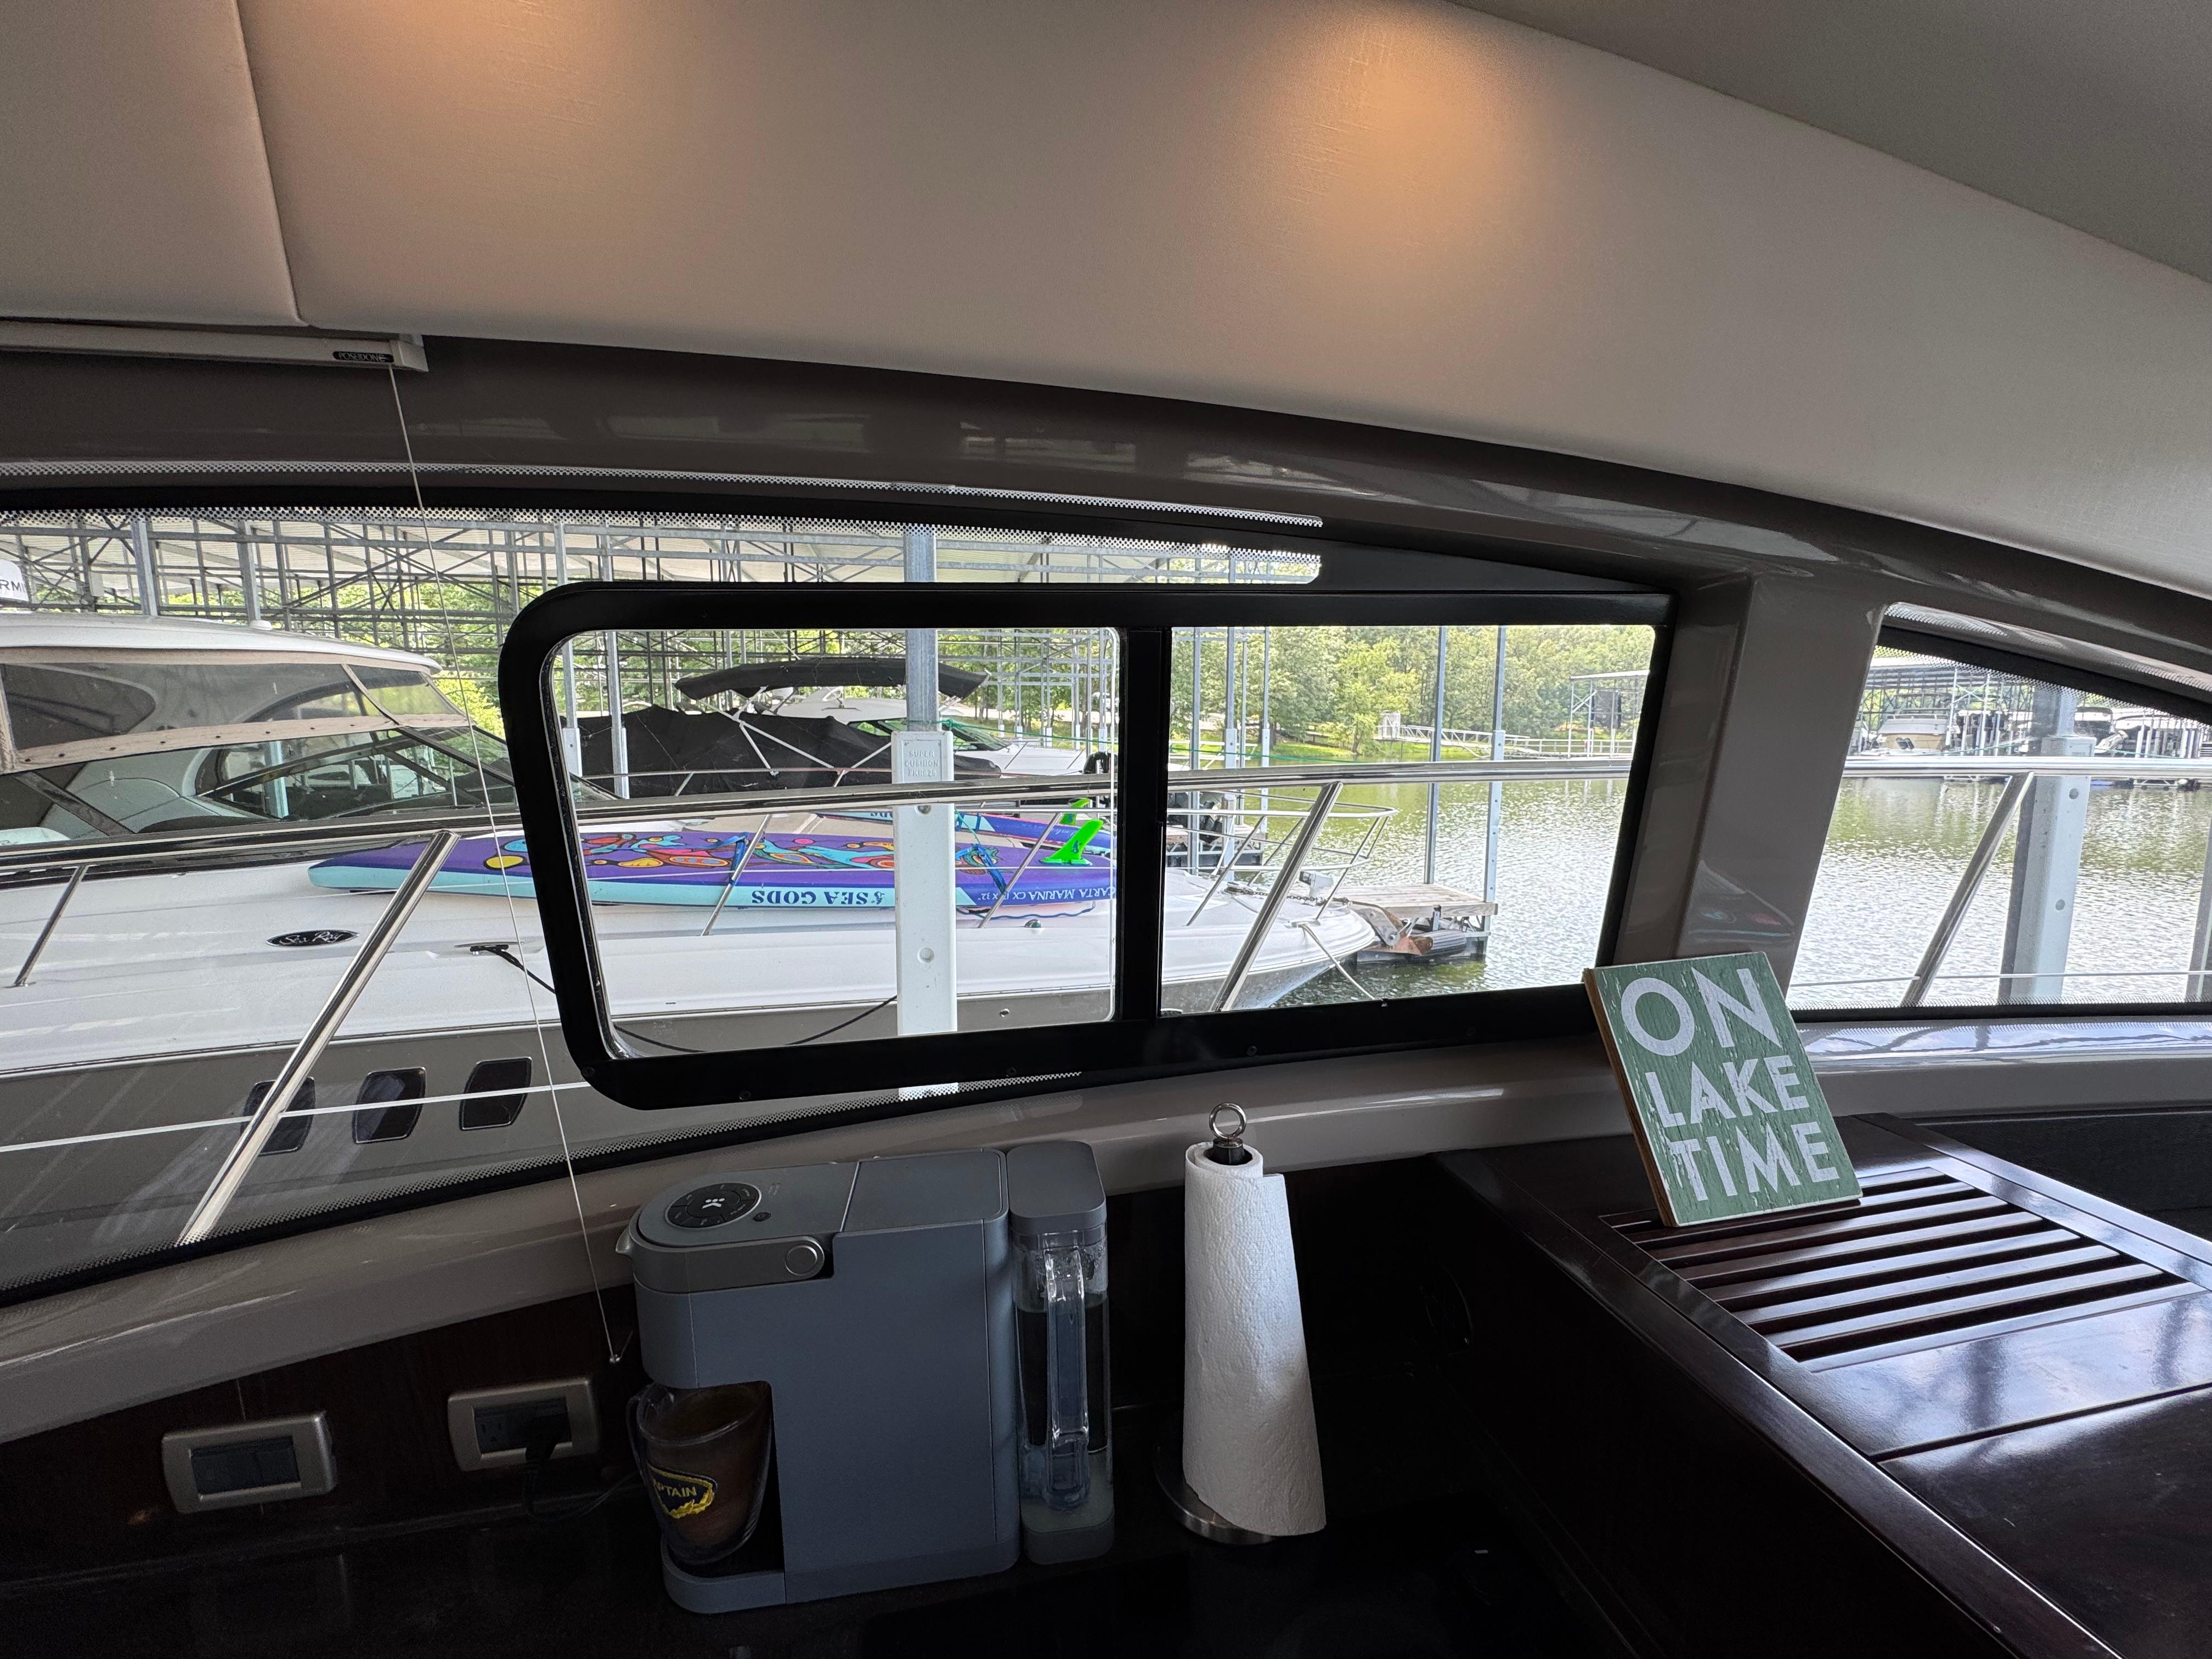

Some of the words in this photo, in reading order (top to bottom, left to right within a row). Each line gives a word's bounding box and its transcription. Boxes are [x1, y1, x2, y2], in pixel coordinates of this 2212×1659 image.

[909, 749, 935, 758] SUPER
[905, 759, 939, 768] CUSHION
[752, 890, 816, 904] GODS
[824, 891, 869, 905] SEA
[1013, 891, 1026, 900] CX
[1029, 889, 1075, 901] MARINA
[1079, 886, 1115, 898] CARTA
[279, 934, 310, 945] Sea
[312, 931, 344, 943] Ray
[1621, 967, 1782, 1056] ON
[1645, 1055, 1810, 1128] LAKE
[1668, 1121, 1840, 1201] TIME
